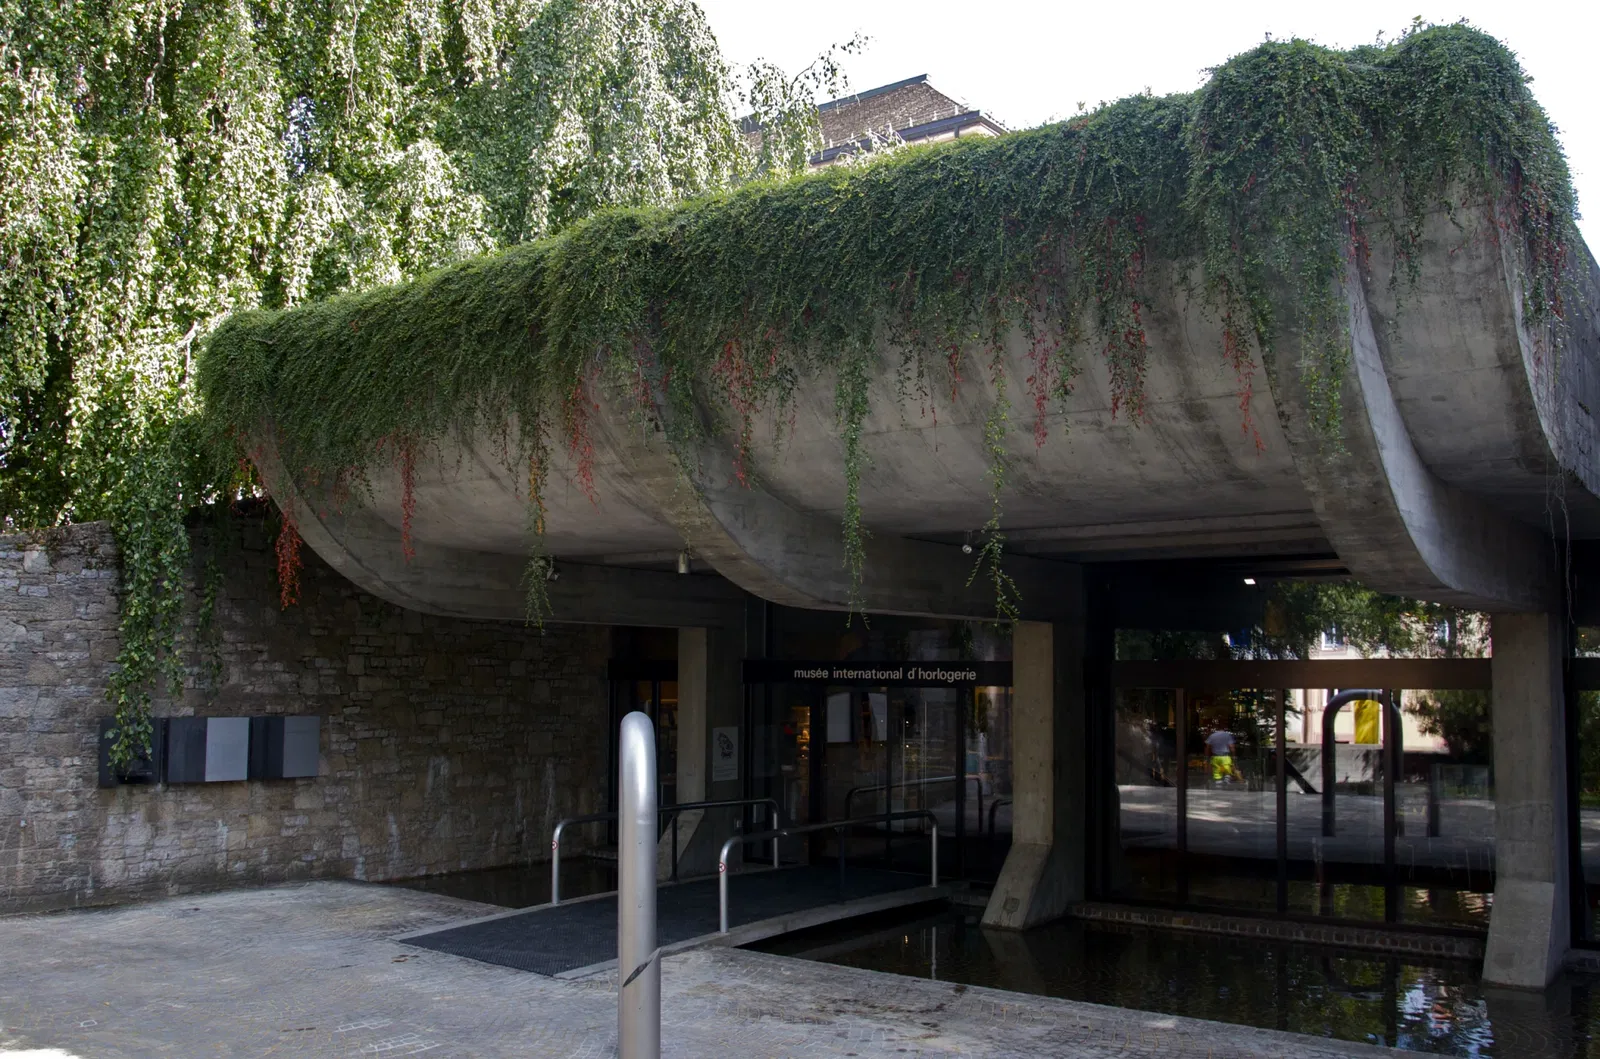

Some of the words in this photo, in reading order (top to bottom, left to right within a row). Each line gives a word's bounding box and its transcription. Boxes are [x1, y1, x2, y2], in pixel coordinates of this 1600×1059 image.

[793, 667, 829, 679] musée
[832, 666, 903, 680] international
[907, 667, 977, 683] d'horlogerie
